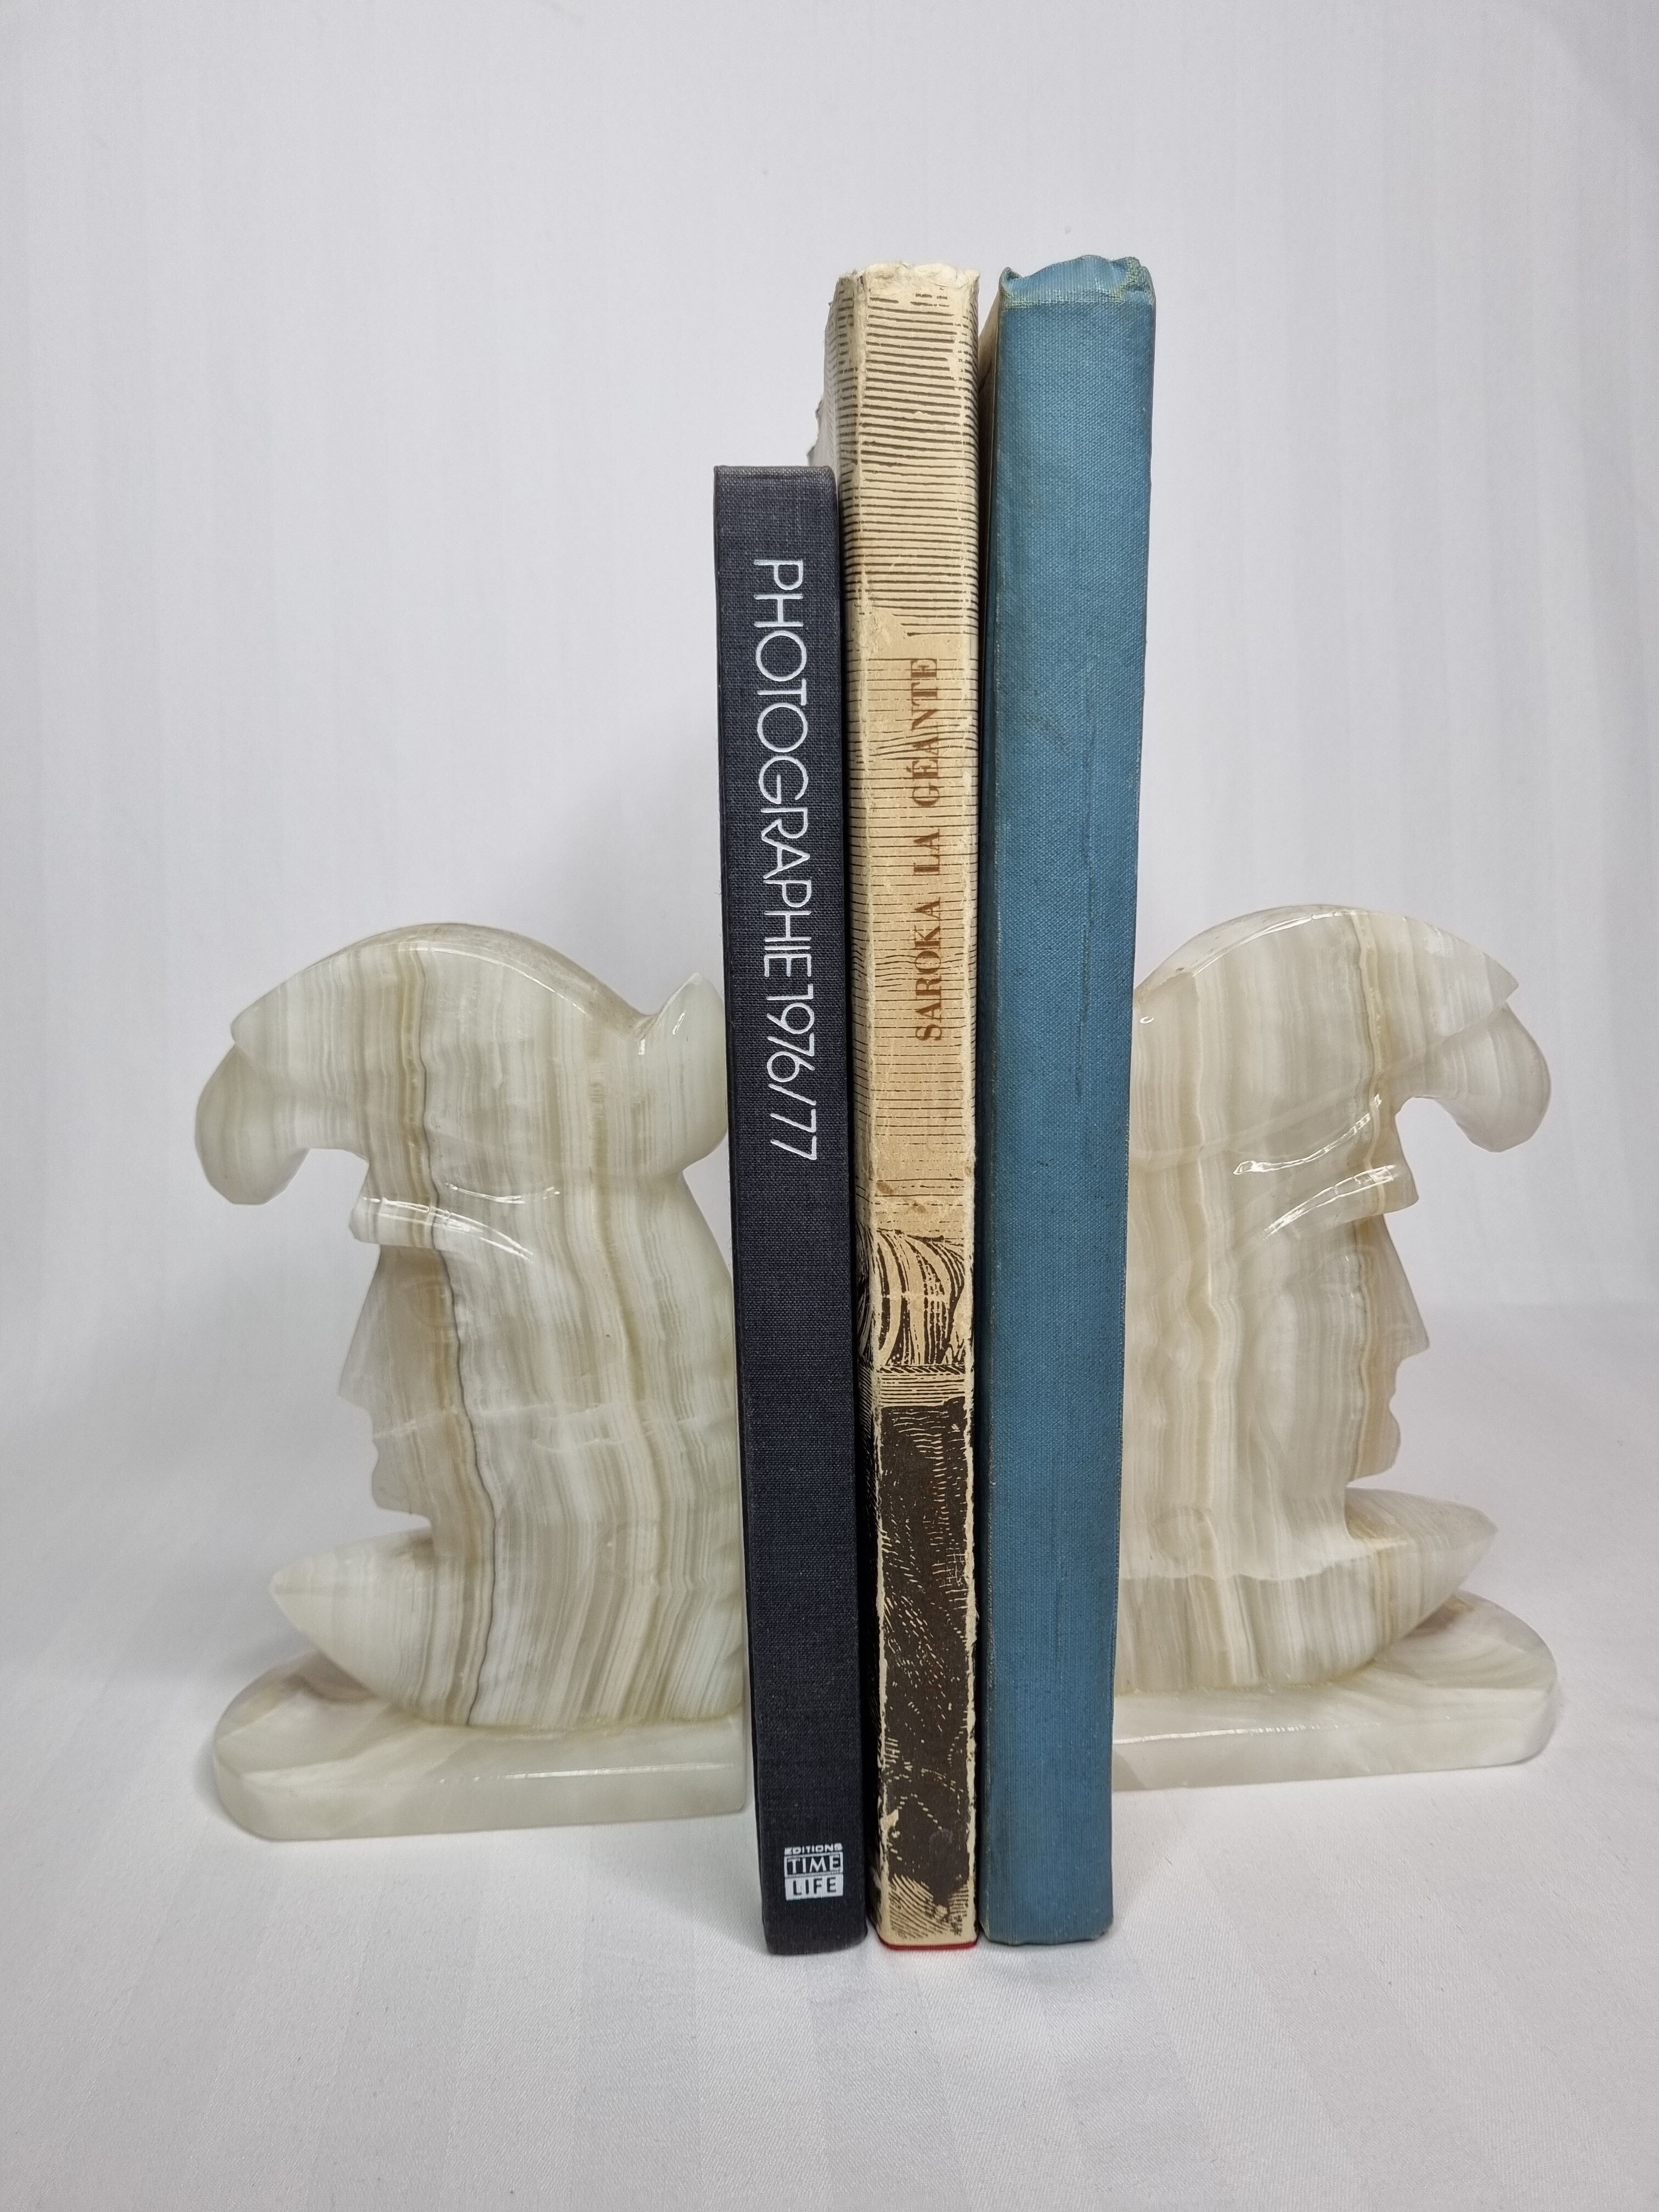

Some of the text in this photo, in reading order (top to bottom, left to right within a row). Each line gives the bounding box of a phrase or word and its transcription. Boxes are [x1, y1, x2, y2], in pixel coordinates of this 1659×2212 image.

[754, 559, 817, 1160] PHOTOGRAPHIE 1976/77
[906, 658, 943, 1042] SAROKA LA GÉANTE
[784, 1842, 843, 1855] EDITIONS
[787, 1854, 841, 1874] TIME
[793, 1877, 837, 1895] LIFE
